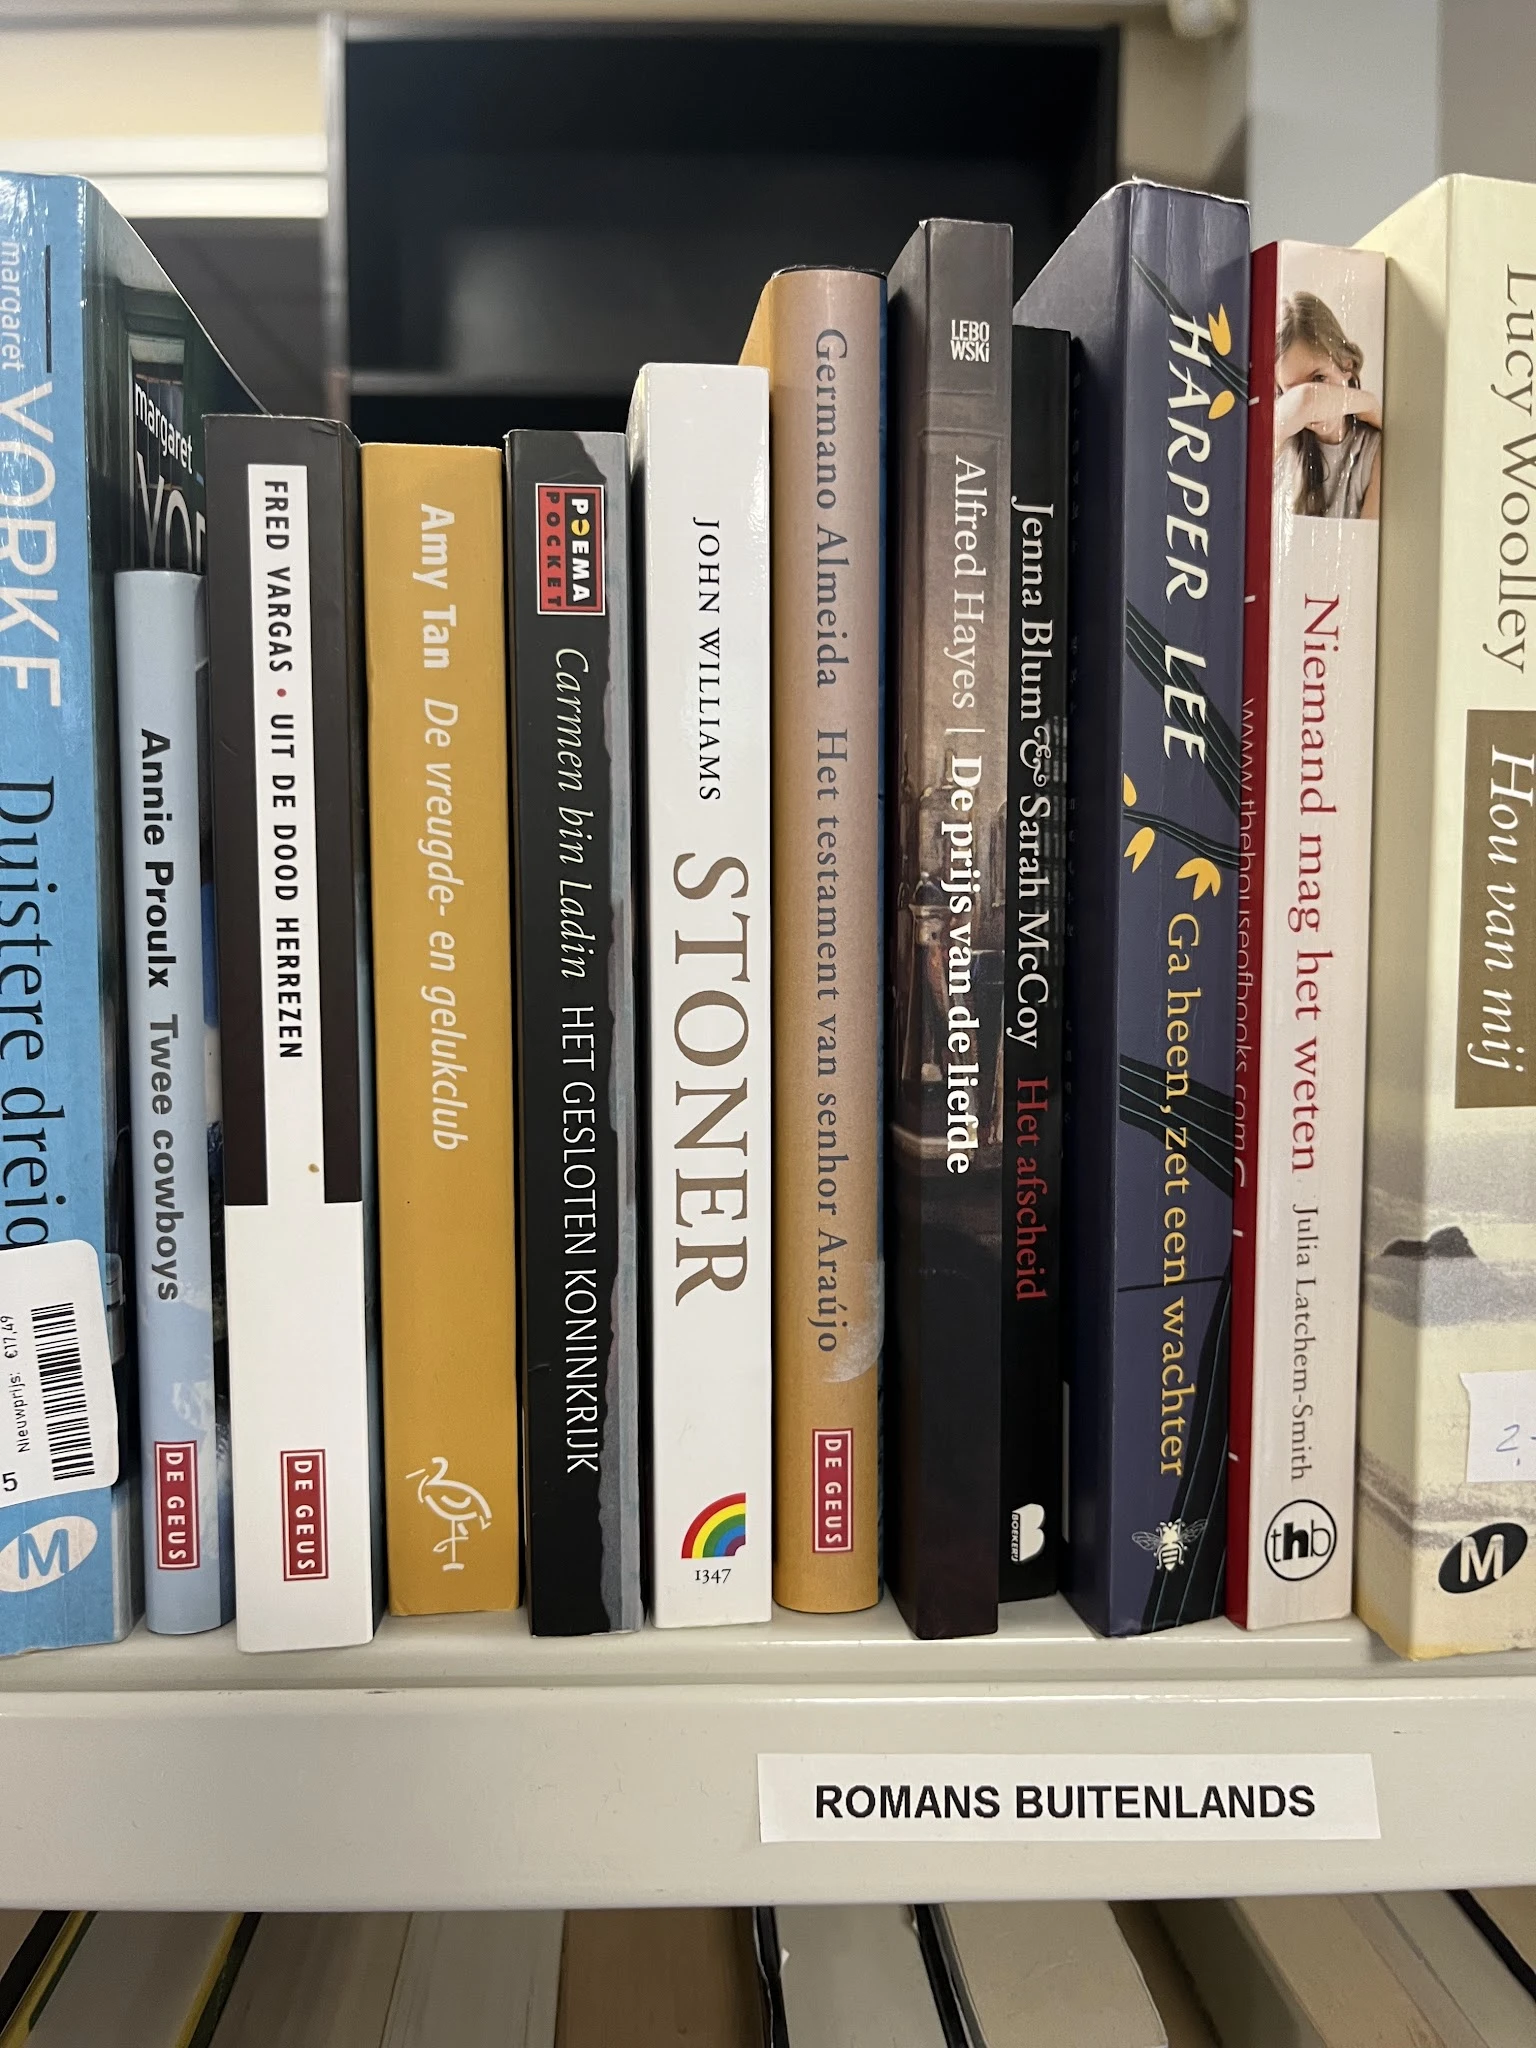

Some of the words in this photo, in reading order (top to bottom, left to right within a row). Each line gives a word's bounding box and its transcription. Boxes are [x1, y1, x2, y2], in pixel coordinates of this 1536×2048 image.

[950, 319, 991, 342] LEBO
[1490, 264, 1536, 417] Lucy
[134, 381, 193, 475] margaret
[815, 328, 848, 511] Germano
[1165, 315, 1212, 605] HARPER
[0, 380, 61, 708] YORKE
[264, 480, 290, 551] FRED
[412, 503, 455, 590] Amy
[546, 491, 562, 608] POCKET
[571, 498, 591, 602] POEMA
[953, 456, 987, 578] Alfred
[1012, 495, 1054, 607] Jenna
[1483, 433, 1536, 673] Woolley
[692, 516, 721, 615] JOHN
[816, 524, 850, 689] Almeida
[265, 567, 292, 672] VARGAS
[422, 604, 457, 669] Tan
[943, 591, 985, 709] Hayes
[698, 626, 722, 802] WILLIAMS
[1020, 619, 1054, 721] Blum
[1163, 645, 1207, 765] LEE
[1301, 594, 1340, 814] Niemand
[269, 713, 294, 758] UIT
[424, 698, 459, 748] De
[555, 648, 589, 792] Carmen
[816, 728, 848, 801] Het
[1019, 726, 1052, 788] &
[141, 728, 173, 846] Annie
[271, 773, 297, 810] DE
[950, 754, 984, 812] De
[1489, 745, 1536, 866] Hou
[272, 822, 299, 902] DOOD
[418, 763, 464, 917] vreugde-
[558, 805, 594, 865] bin
[939, 820, 983, 916] prijs
[1018, 796, 1051, 900] Sarah
[1288, 833, 1323, 932] mag
[0, 774, 58, 1062] Duistere
[145, 861, 177, 988] Proulx
[429, 931, 456, 972] en
[559, 880, 596, 979] Ladin
[816, 814, 848, 1000] testament
[1167, 912, 1201, 975] Ga
[1485, 881, 1517, 973] van
[276, 917, 304, 1058] HERREZEN
[946, 924, 974, 998] van
[1006, 910, 1050, 1049] McCoy
[1296, 948, 1332, 1021] het
[149, 1014, 179, 1115] Twee
[421, 985, 468, 1151] gelukclub
[562, 1006, 595, 1071] HET
[673, 852, 751, 1307] STONER
[814, 1012, 840, 1079] van
[946, 1004, 981, 1056] de
[1160, 987, 1202, 1113] heen,
[1468, 987, 1525, 1074] mij
[945, 1062, 981, 1176] liefde
[1016, 1078, 1048, 1146] Het
[1292, 1036, 1317, 1172] weten
[562, 1081, 598, 1255] GESLOTEN
[814, 1091, 852, 1217] senhor
[1162, 1125, 1191, 1197] zet
[151, 1129, 184, 1301] cowboys
[1015, 1158, 1048, 1301] afscheid
[1161, 1205, 1189, 1287] een
[1293, 1204, 1319, 1266] Julia
[807, 1228, 848, 1353] Araújo
[11, 1371, 30, 1453] Nieuwprijs:
[564, 1268, 599, 1474] KONINKRIJK
[1160, 1296, 1196, 1476] wachter
[1291, 1277, 1317, 1480] Latchem-Smith
[165, 1452, 184, 1484] DE
[294, 1460, 313, 1492] DE
[823, 1437, 843, 1469] DE
[19, 1529, 68, 1579] M
[166, 1495, 186, 1562] GEUS
[295, 1504, 316, 1571] GEUS
[824, 1480, 843, 1545] GEUS
[1271, 1519, 1332, 1562] thb
[1459, 1533, 1505, 1583] M
[692, 1567, 734, 1587] 1347
[815, 1784, 1001, 1821] ROMANS
[1015, 1784, 1315, 1820] BUITENLANDS
